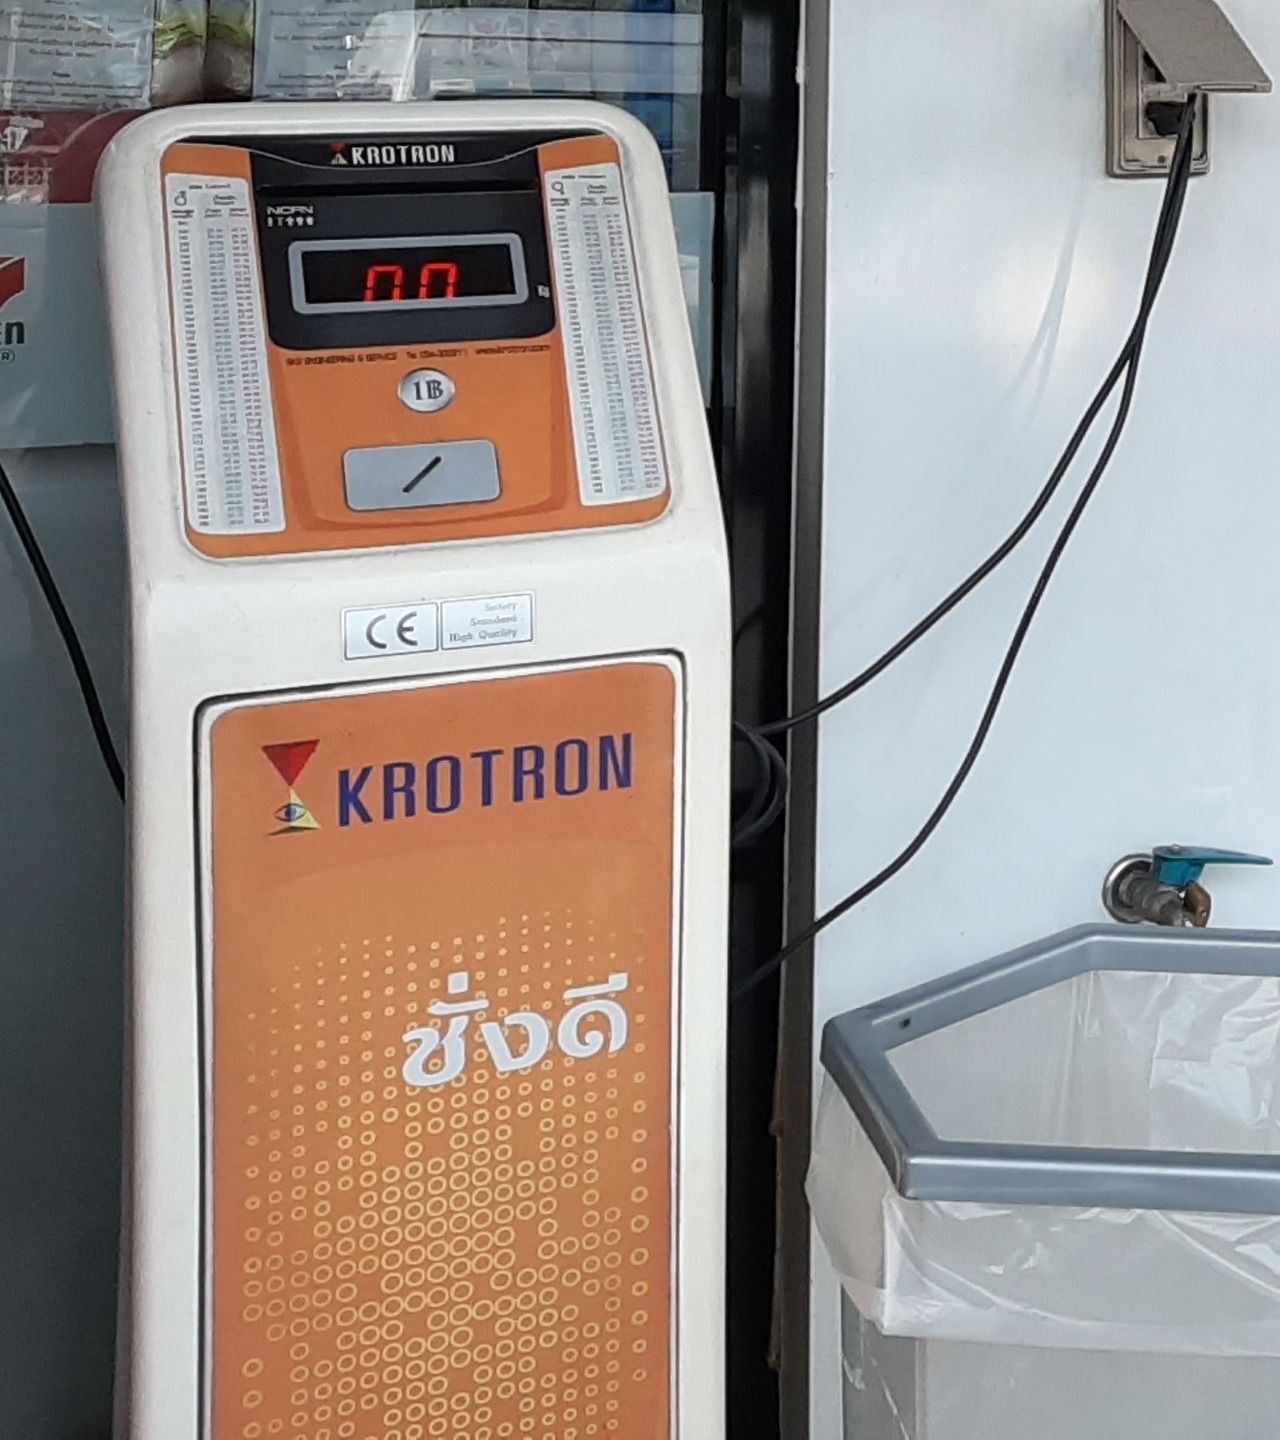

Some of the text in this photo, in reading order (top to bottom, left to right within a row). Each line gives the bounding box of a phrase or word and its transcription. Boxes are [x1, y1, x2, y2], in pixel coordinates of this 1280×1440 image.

[351, 145, 456, 165] KROTRON
[366, 611, 418, 649] CE
[336, 730, 634, 828] KROTRON
[402, 970, 629, 1089] ชั่งดี
